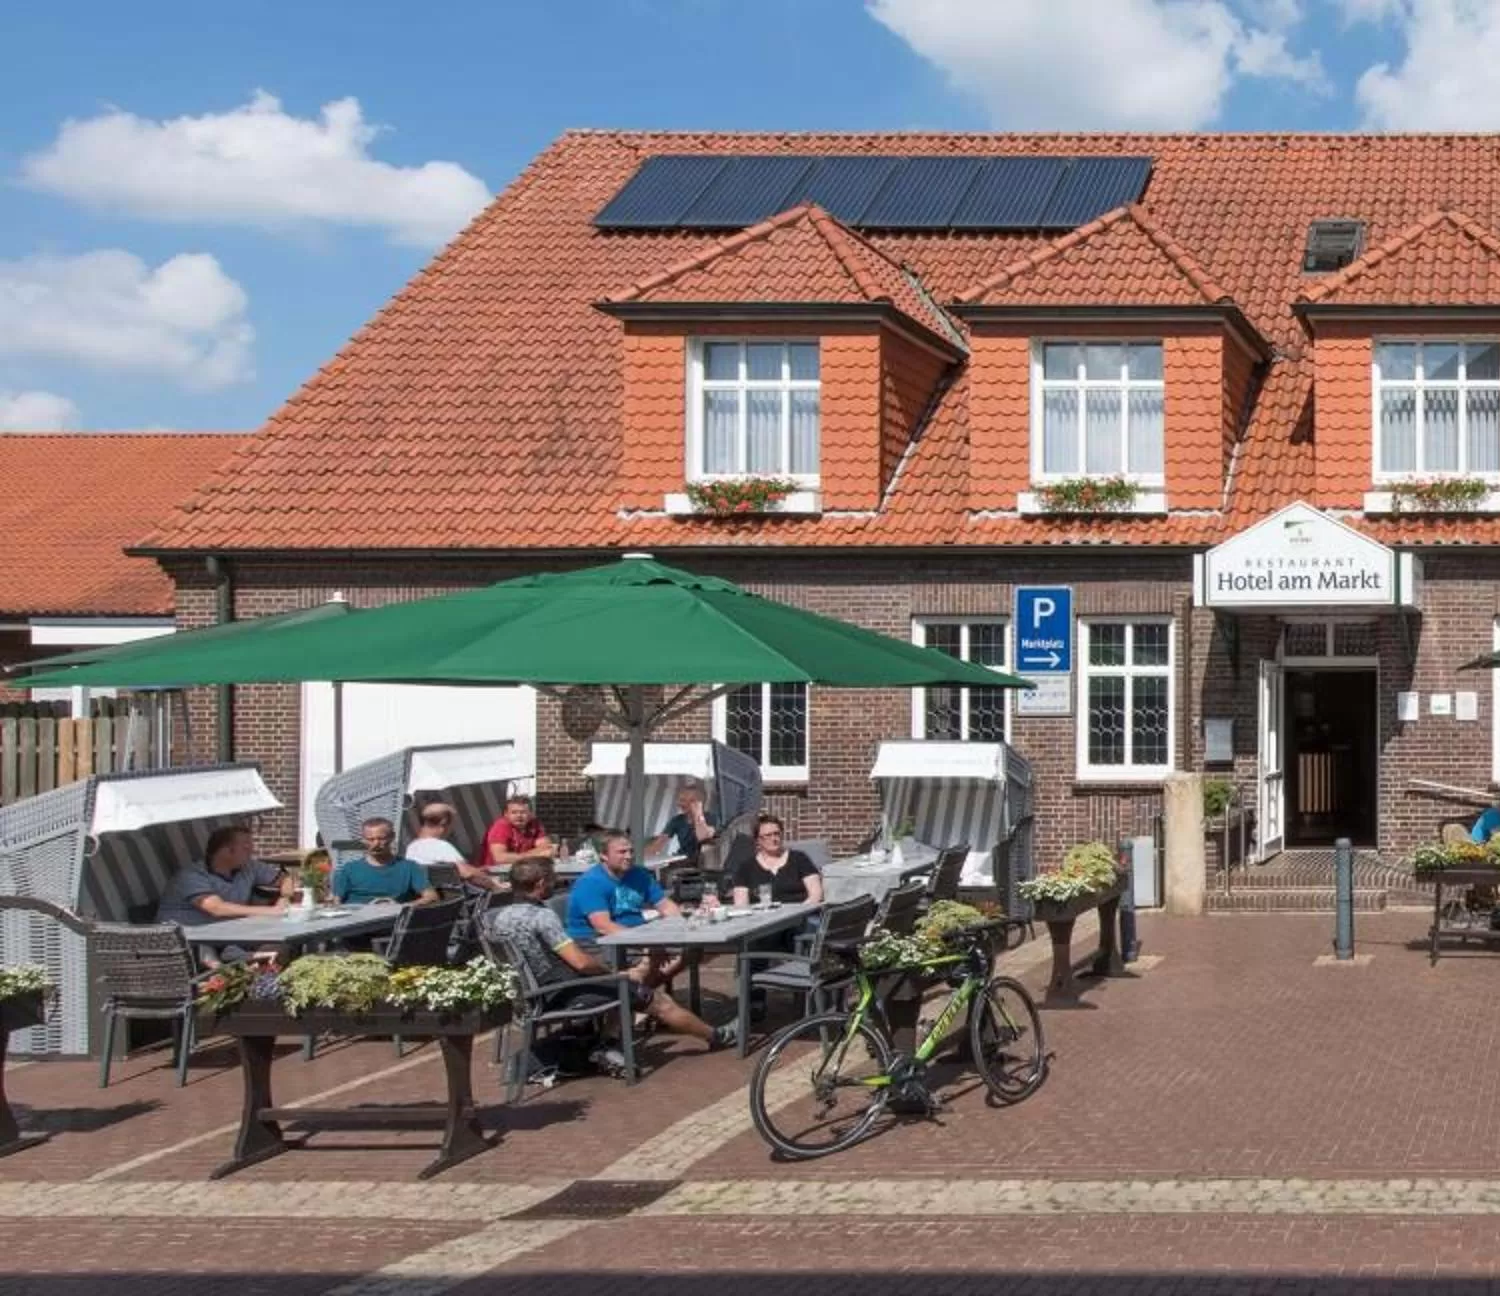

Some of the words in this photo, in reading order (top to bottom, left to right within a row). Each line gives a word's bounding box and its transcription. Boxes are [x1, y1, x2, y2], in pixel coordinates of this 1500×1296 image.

[1245, 557, 1355, 568] RESTAURANT
[1217, 570, 1273, 591] Hotel
[1278, 574, 1312, 590] am
[1317, 569, 1382, 590] Markt
[1033, 597, 1056, 629] P
[1021, 638, 1065, 651] Marktplatz
